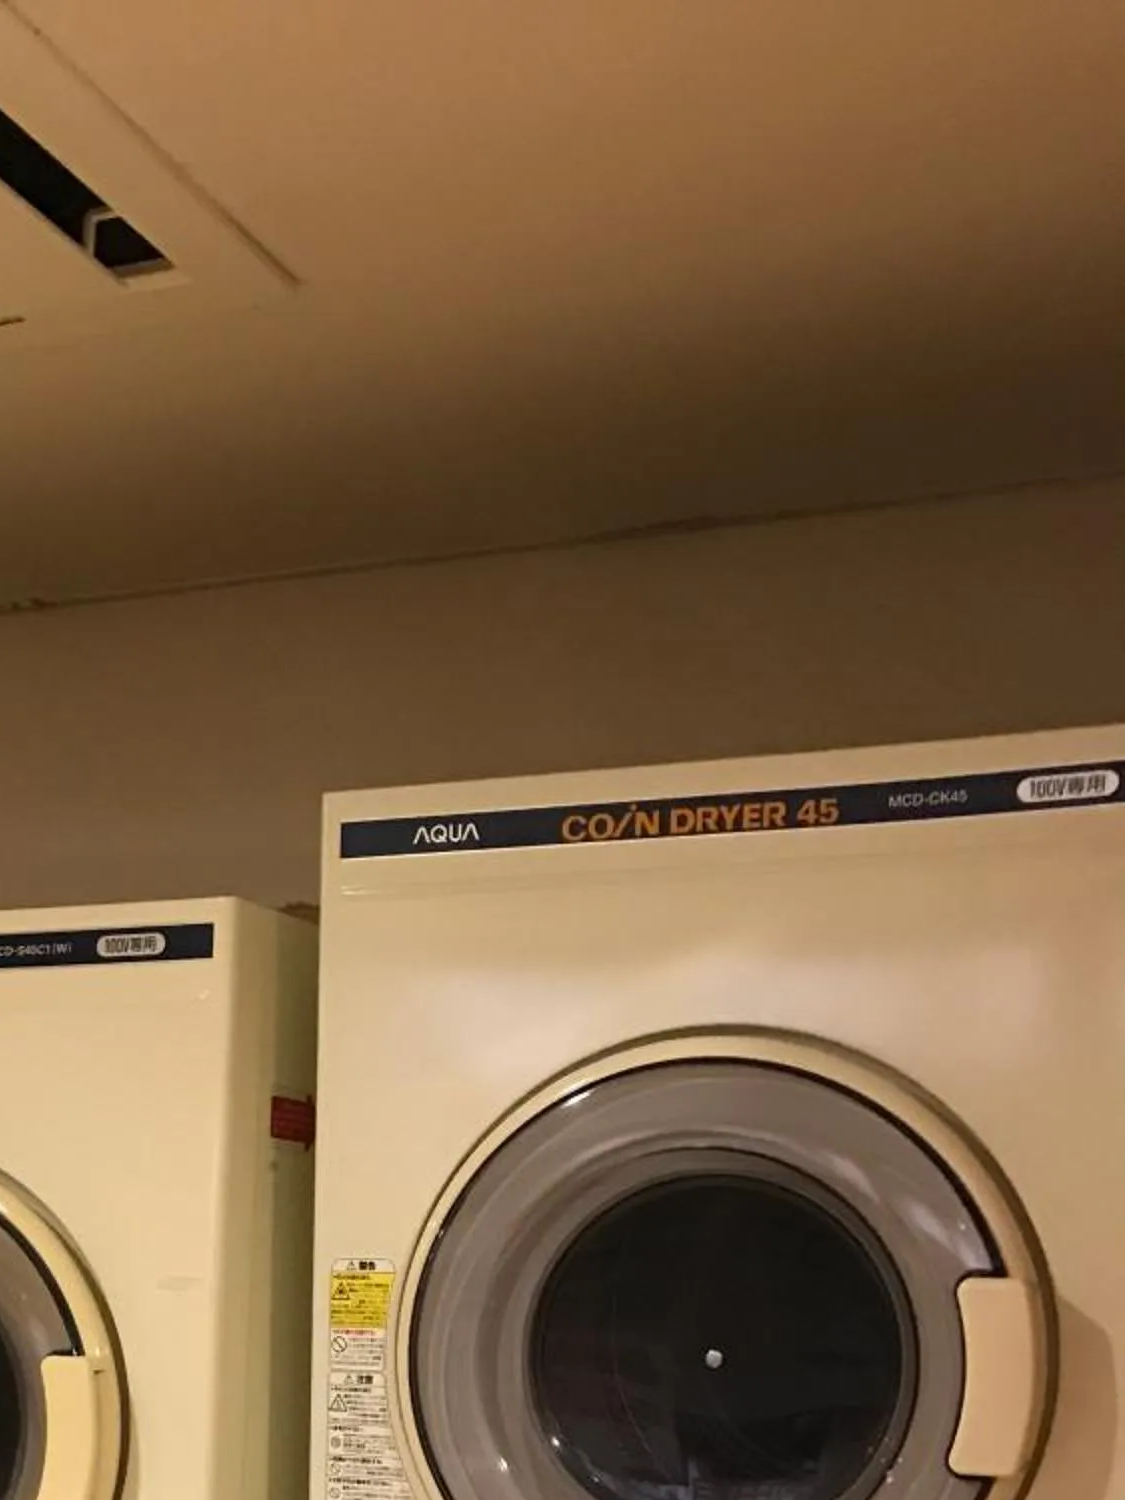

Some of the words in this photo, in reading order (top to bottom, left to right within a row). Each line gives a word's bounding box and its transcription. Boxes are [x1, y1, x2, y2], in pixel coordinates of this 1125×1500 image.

[888, 789, 968, 810] MCD-CK45
[669, 803, 787, 837] DRYER
[796, 798, 839, 826] 45
[413, 822, 479, 845] AQUA
